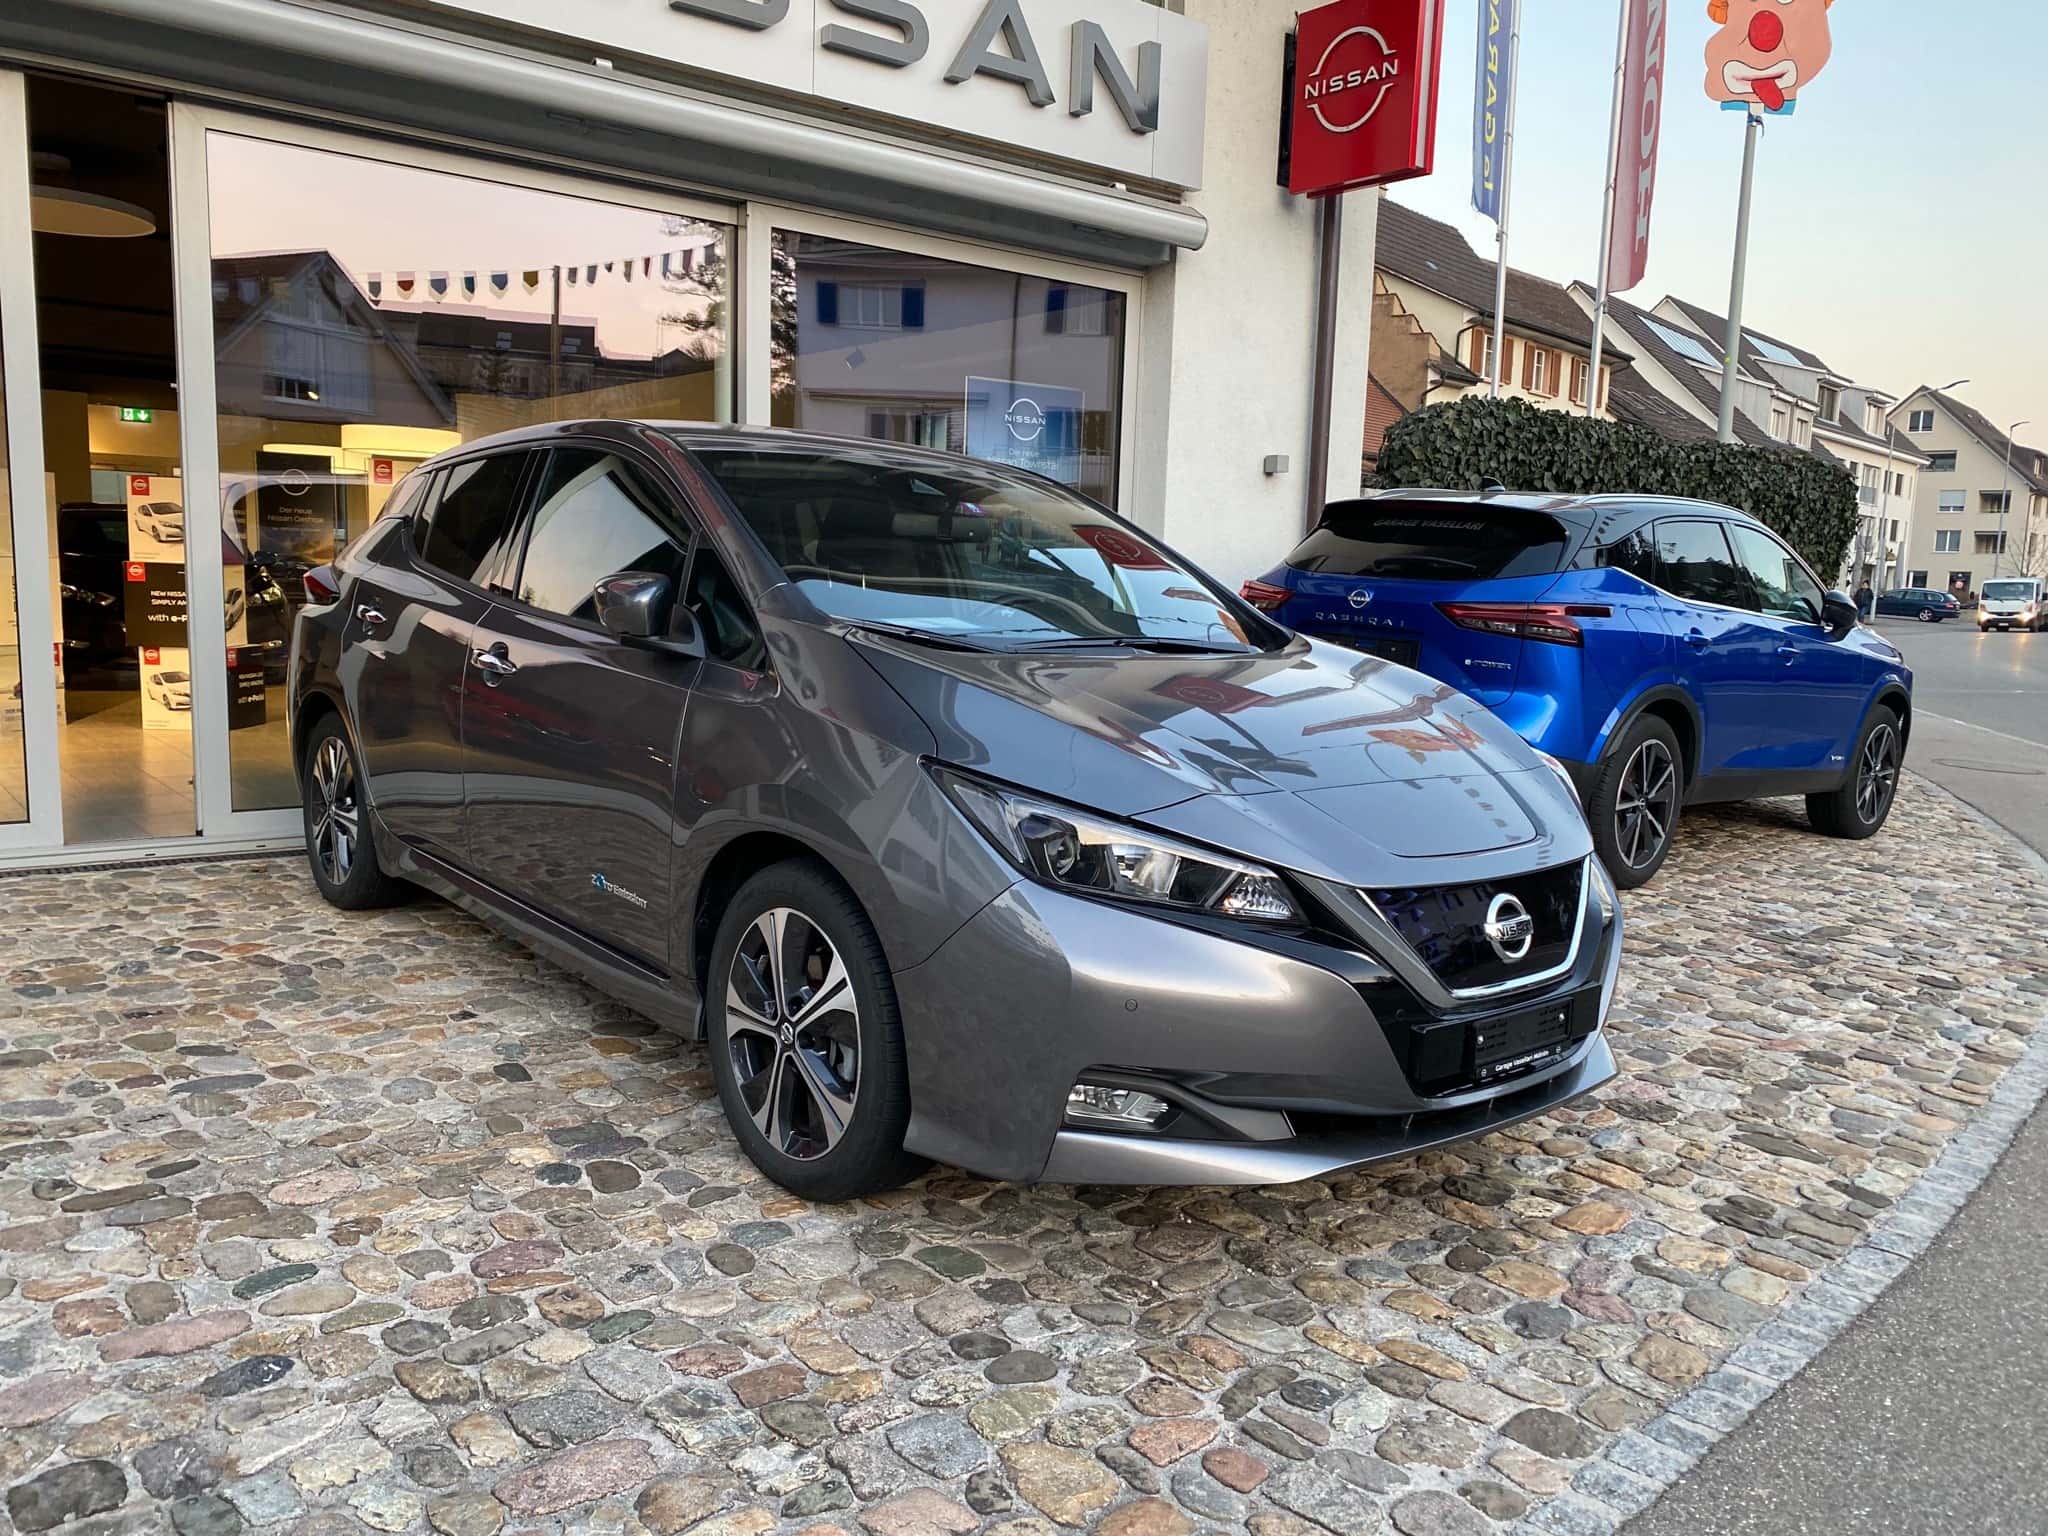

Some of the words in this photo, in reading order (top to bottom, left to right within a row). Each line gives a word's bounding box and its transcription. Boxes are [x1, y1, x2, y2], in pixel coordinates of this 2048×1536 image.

[1304, 58, 1398, 100] NISSAN
[1004, 414, 1046, 425] NISSAN
[147, 613, 169, 622] with
[1315, 611, 1405, 628] QASHQAI
